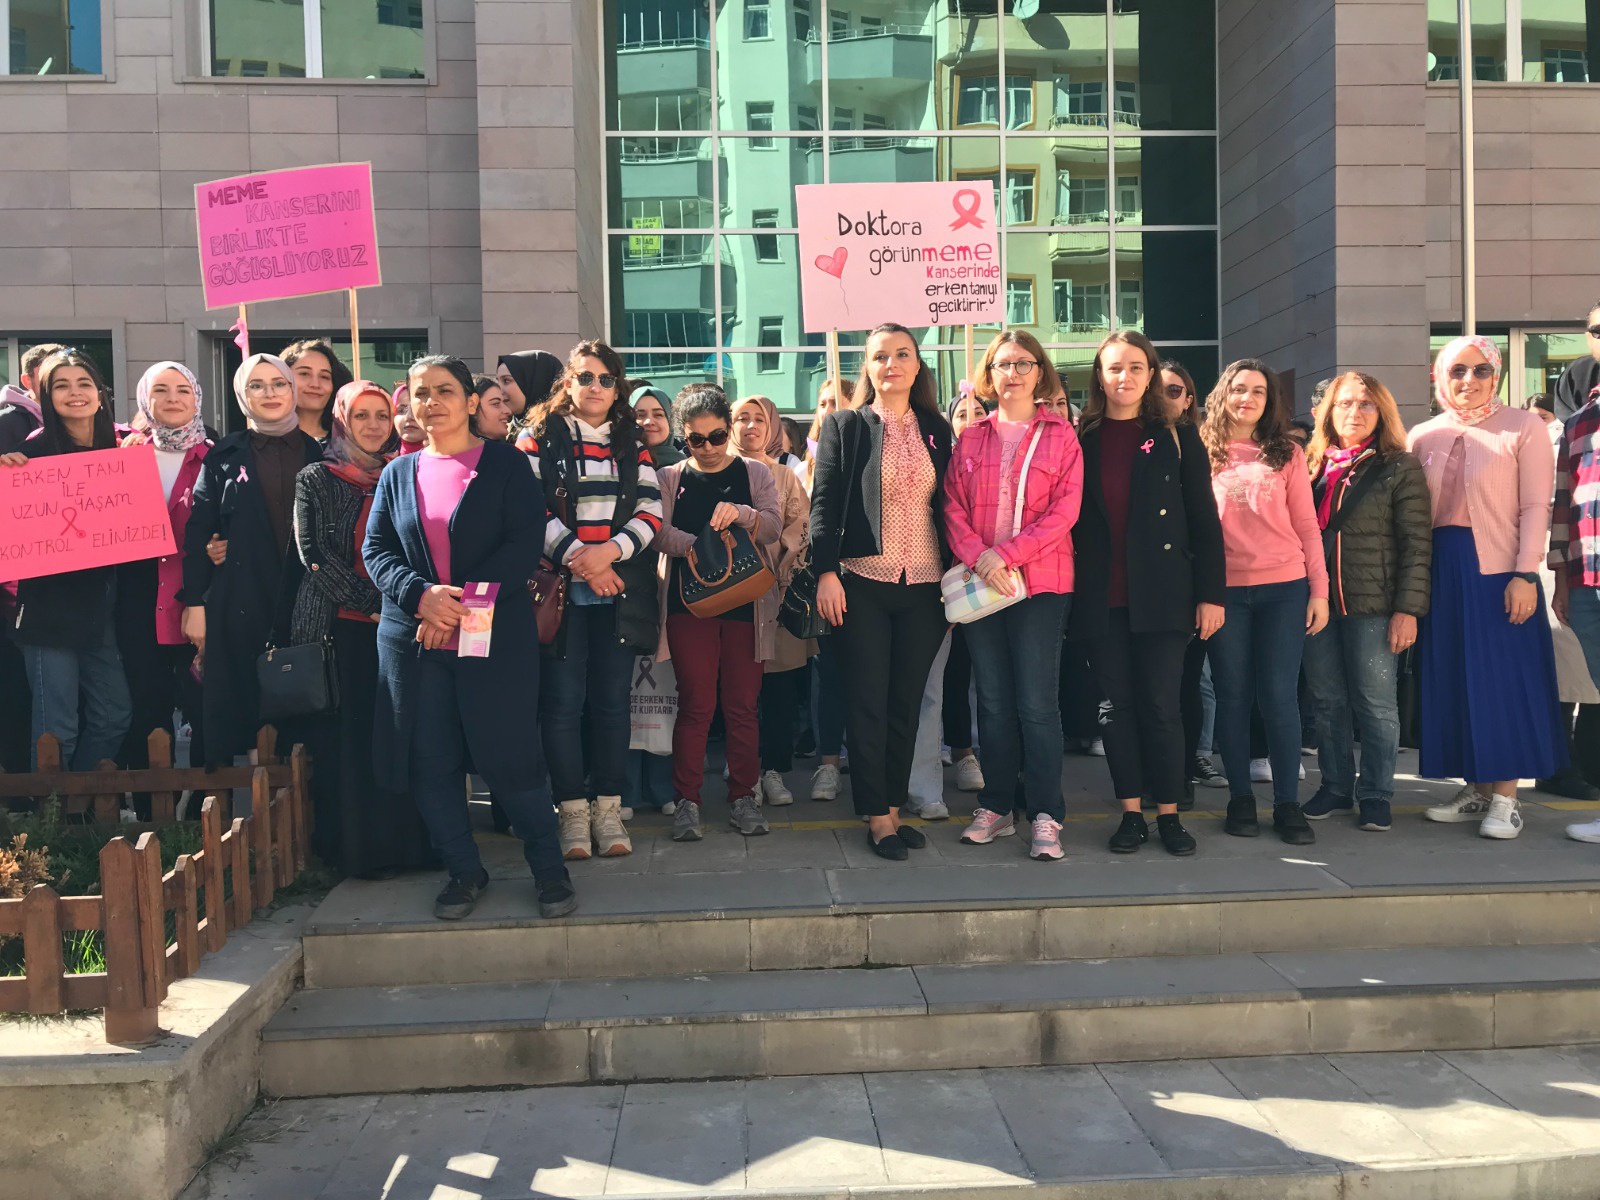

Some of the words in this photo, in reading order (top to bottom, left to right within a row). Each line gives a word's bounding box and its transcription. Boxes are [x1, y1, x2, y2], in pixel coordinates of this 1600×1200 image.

[208, 180, 268, 208] MEME
[246, 189, 361, 223] KANSERİNİ
[838, 209, 922, 237] Doktora
[210, 223, 308, 256] BİRLİKTE
[207, 244, 368, 288] GÖĞÜSLÜYORUZ
[925, 282, 968, 297] erken
[12, 466, 71, 488] ERKEN
[84, 460, 125, 479] TANI
[62, 481, 86, 498] İLE
[12, 501, 58, 520] UZUN
[0, 538, 75, 561] KONTROL
[640, 695, 664, 704] ERKEN
[665, 696, 677, 705] TES
